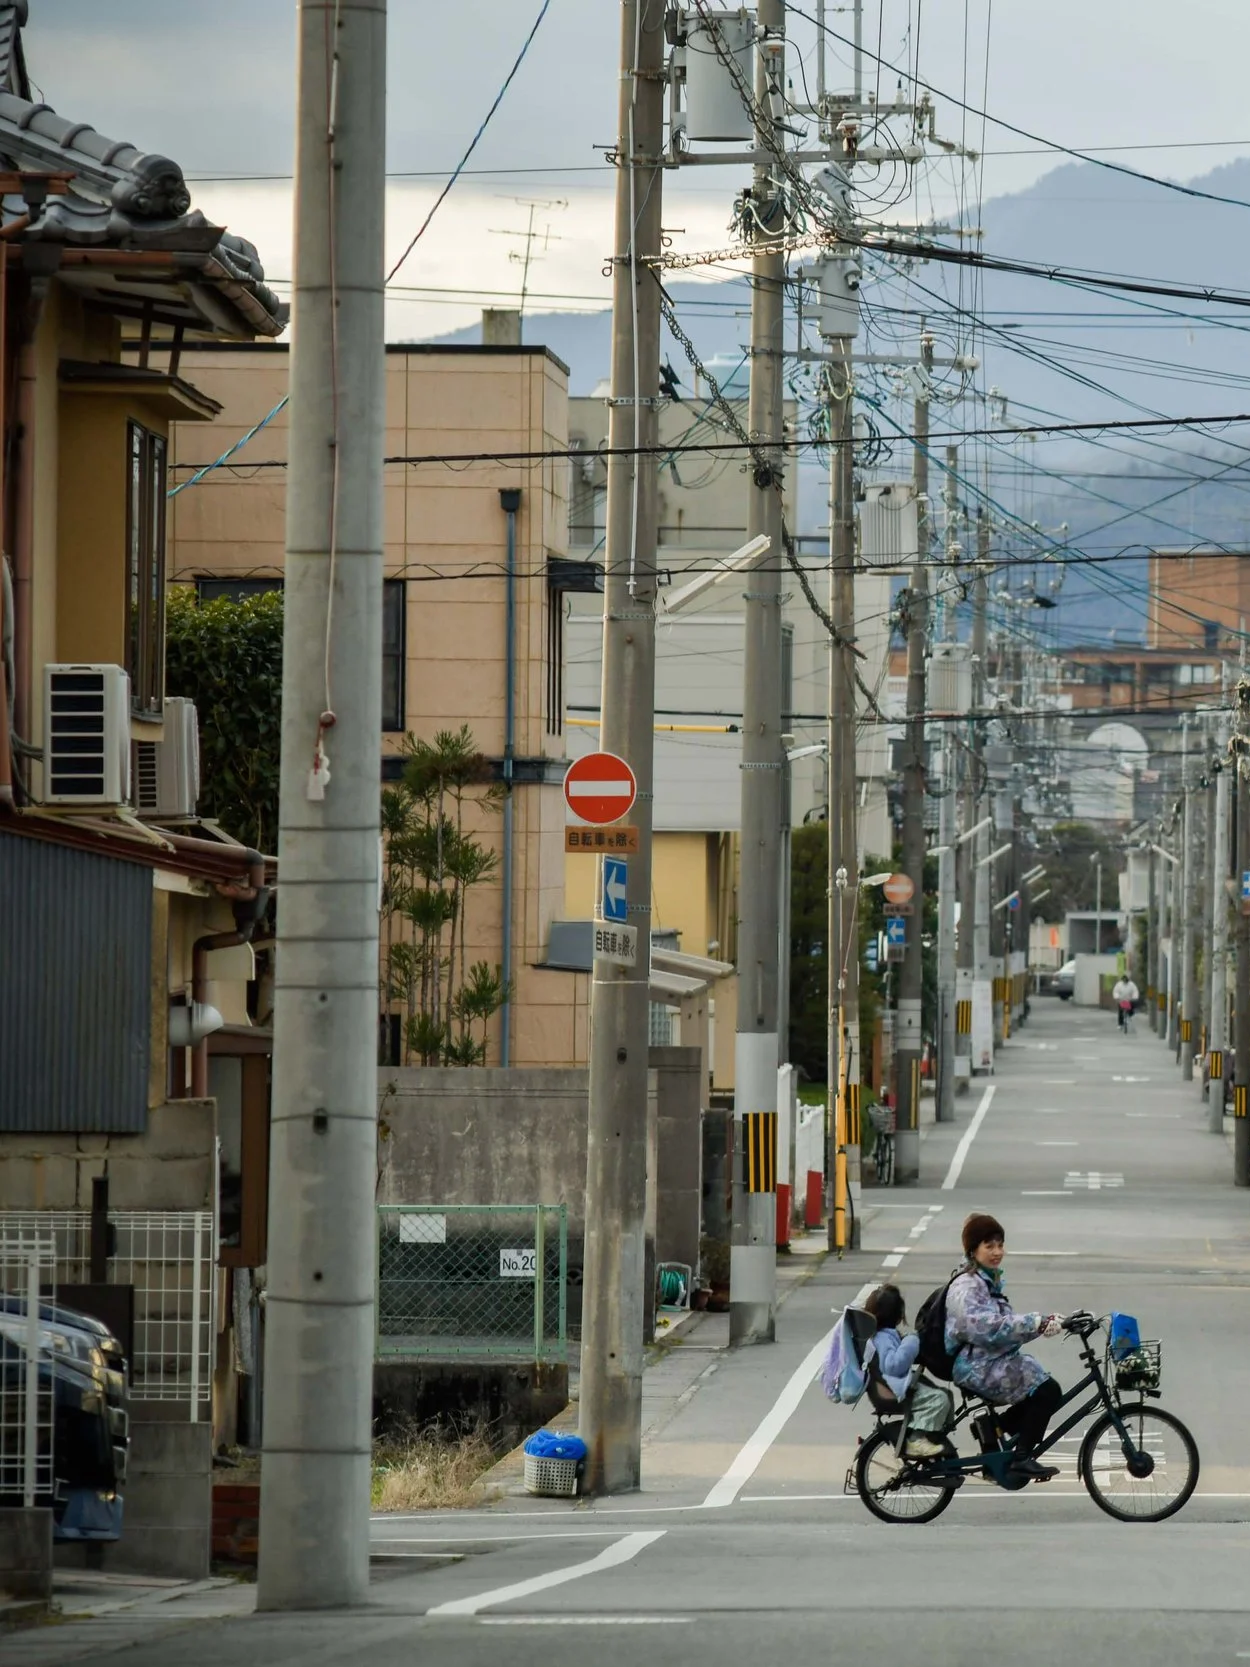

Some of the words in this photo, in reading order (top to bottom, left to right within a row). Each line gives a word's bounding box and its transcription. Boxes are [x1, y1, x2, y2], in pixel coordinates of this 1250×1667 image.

[569, 832, 636, 848] 自転車を除く
[596, 929, 636, 959] 自転車を除く
